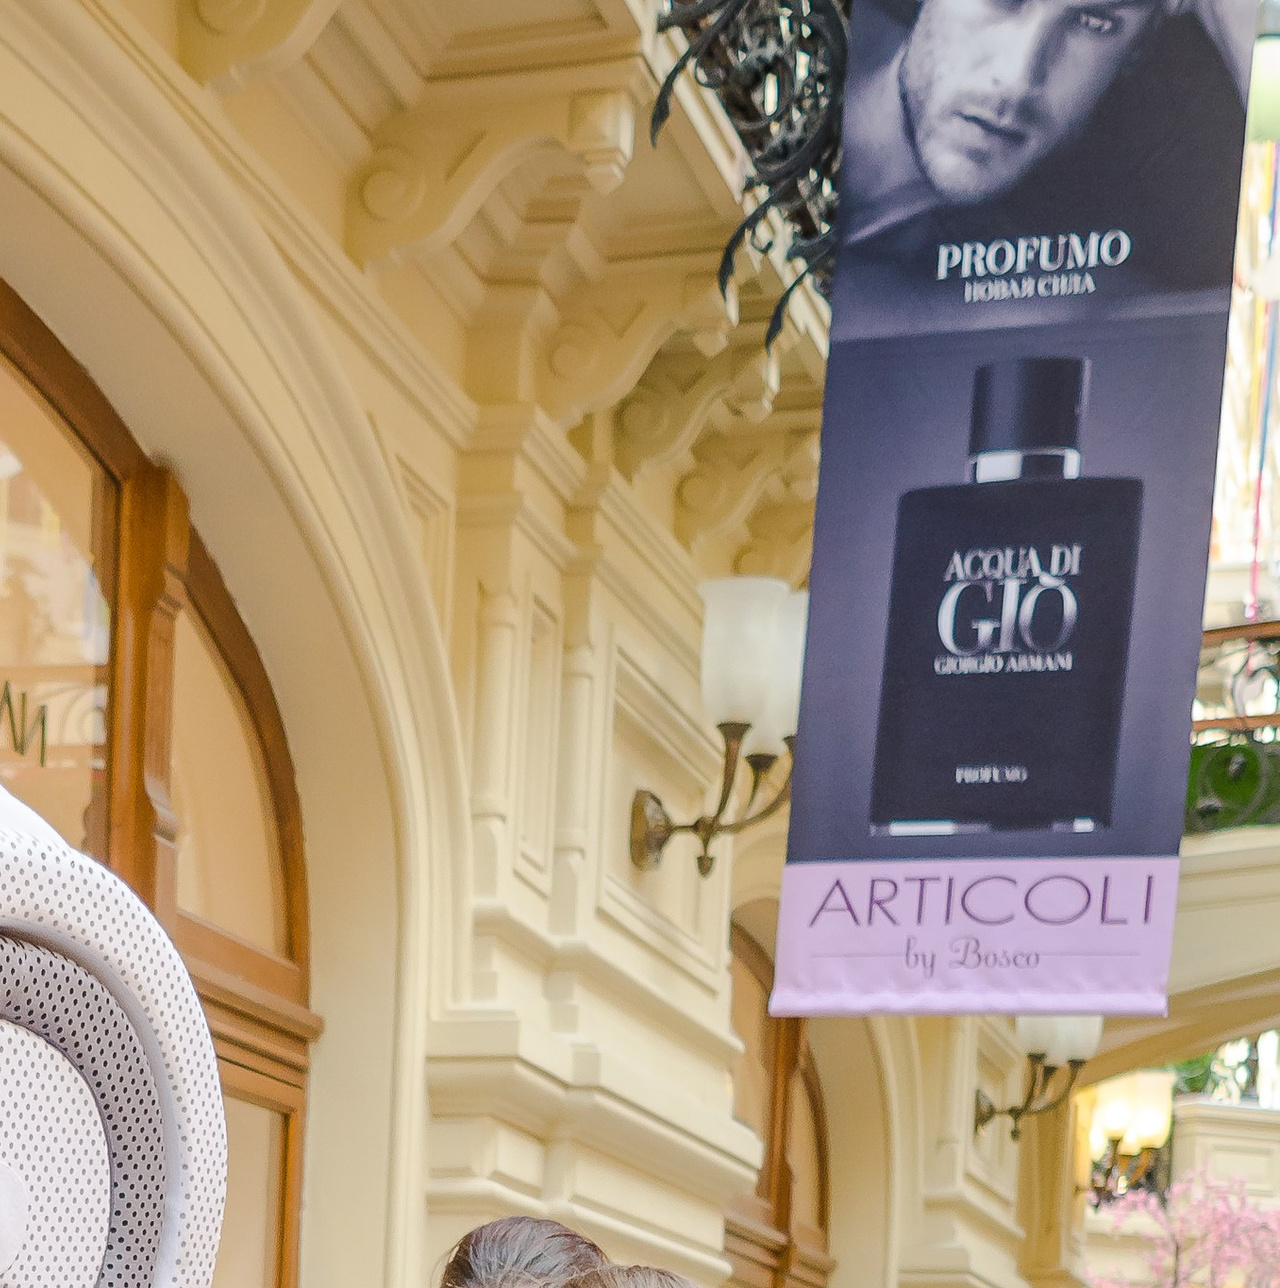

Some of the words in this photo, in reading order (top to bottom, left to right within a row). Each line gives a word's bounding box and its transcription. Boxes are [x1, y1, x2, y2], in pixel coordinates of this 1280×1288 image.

[936, 228, 1132, 281] PROFUMO
[943, 546, 1042, 582] ACQUA
[1050, 542, 1083, 576] DI
[933, 653, 1005, 675] GIORGIO
[1005, 651, 1073, 673] ARMANI
[809, 873, 1154, 928] ARTICOLI
[905, 935, 936, 979] by
[948, 936, 1040, 970] Bosco
